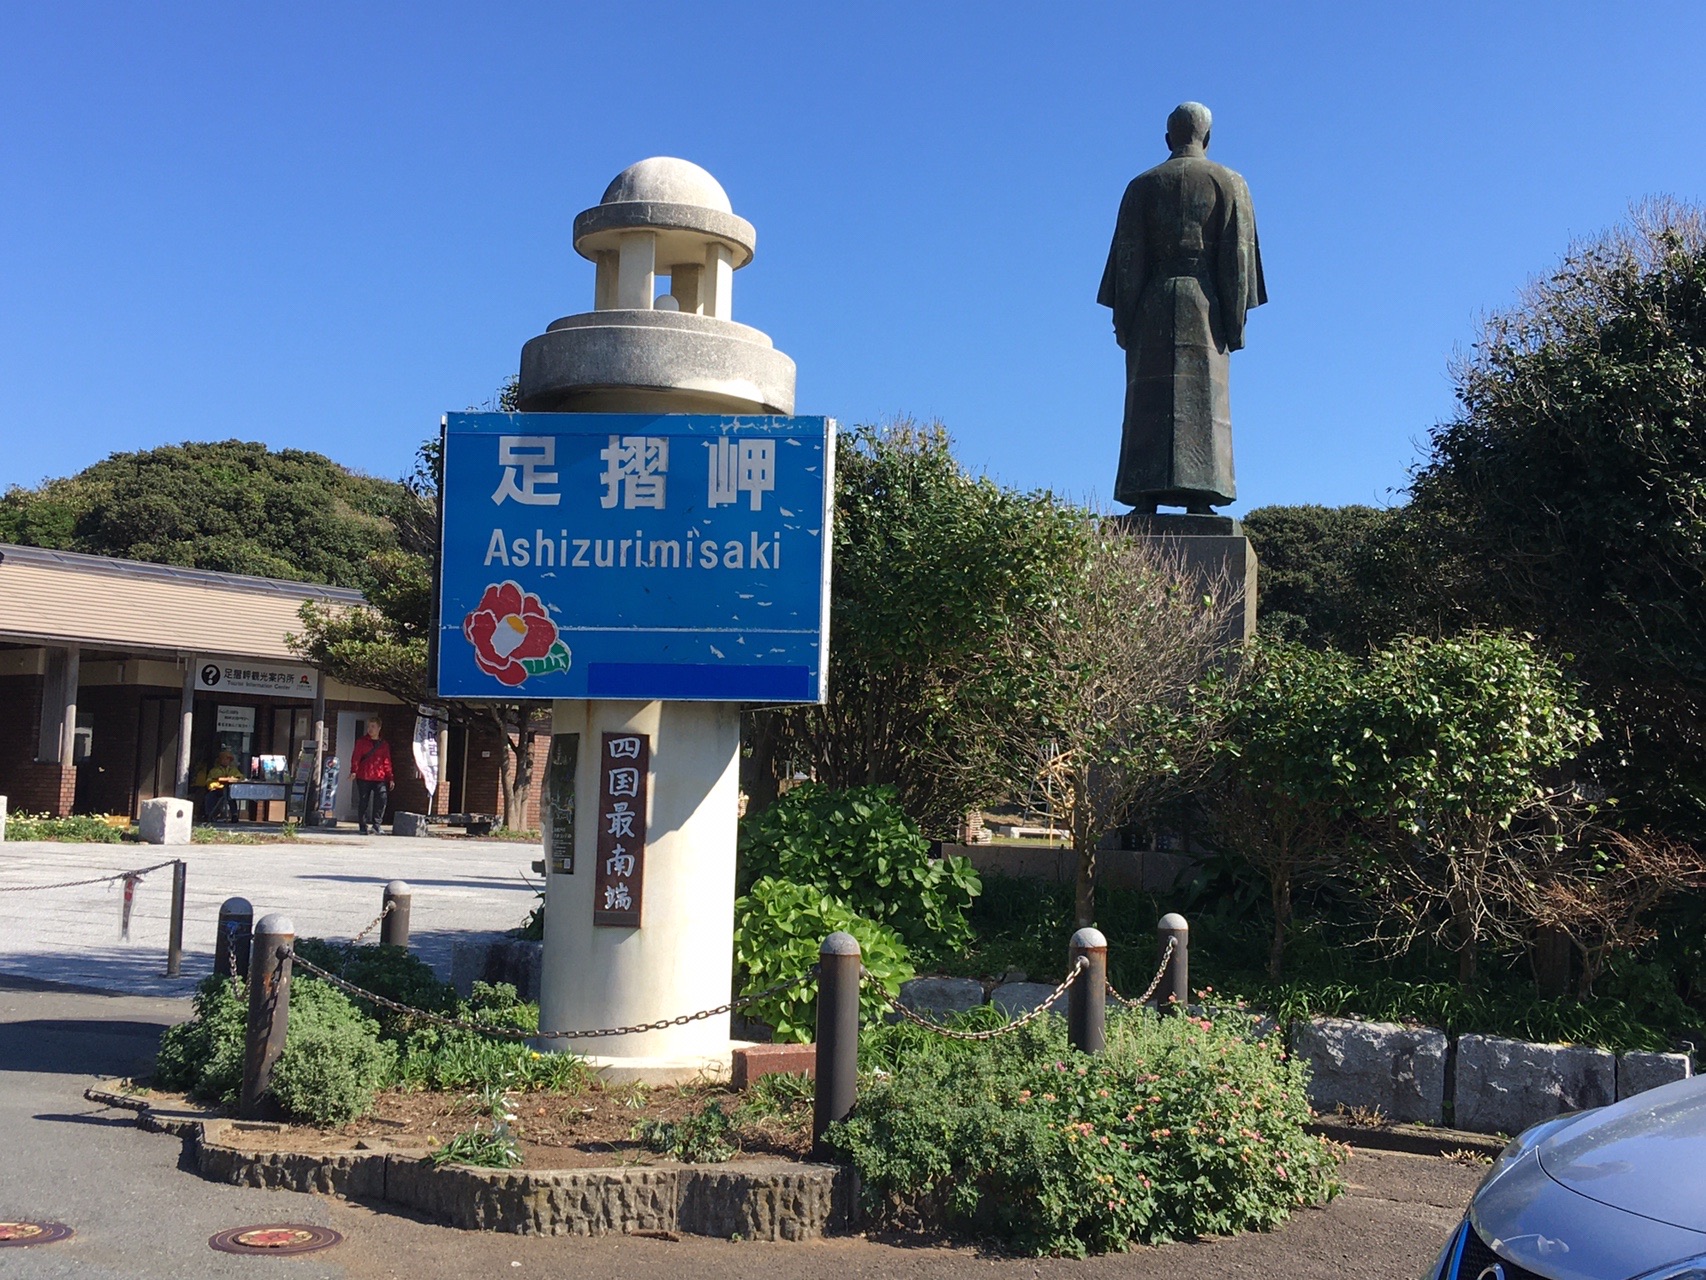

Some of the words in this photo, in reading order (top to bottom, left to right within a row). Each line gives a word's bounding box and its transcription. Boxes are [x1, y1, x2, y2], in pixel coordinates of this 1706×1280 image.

[491, 434, 775, 511] 足摺岬
[483, 528, 781, 570] Ashizurimisaki
[604, 736, 641, 911] 四国最南端
